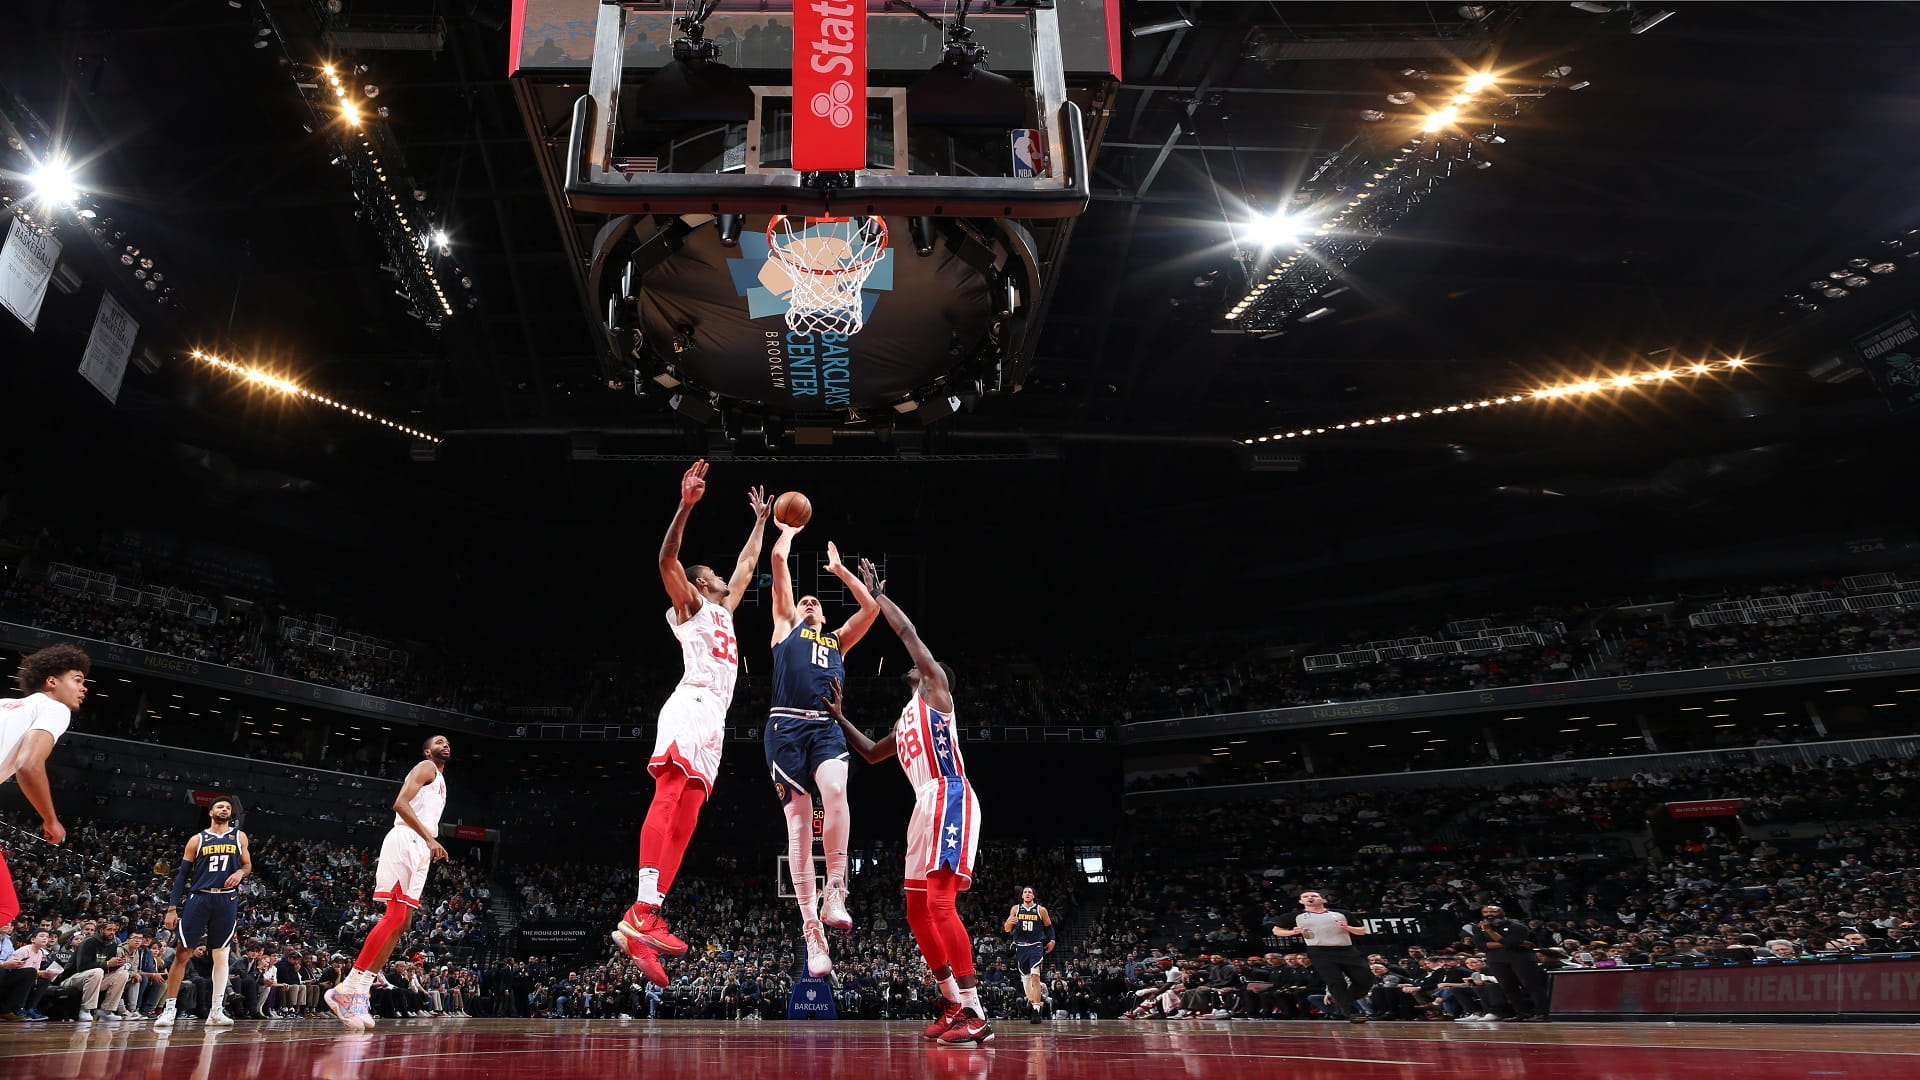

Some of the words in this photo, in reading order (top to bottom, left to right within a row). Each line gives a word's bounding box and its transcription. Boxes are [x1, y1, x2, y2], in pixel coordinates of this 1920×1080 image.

[811, 0, 855, 76] Stat
[1018, 169, 1033, 178] NBA
[14, 226, 51, 269] BASKETBALL
[100, 312, 131, 349] BASKETBALL
[110, 307, 128, 332] NETS
[1863, 326, 1919, 360] CHAMPIONS
[765, 331, 786, 389] BROOKLYN
[785, 330, 819, 399] CENTER
[821, 331, 851, 405] BARCLAYS
[800, 628, 838, 650] DENVER
[144, 654, 199, 674] NUGGETS
[811, 641, 829, 668] 15
[1726, 666, 1788, 680] NETS
[360, 697, 387, 711] NETS
[1311, 703, 1399, 718] NUGGETS
[899, 728, 923, 769] 28
[202, 844, 237, 856] DENVER
[208, 855, 230, 872] 27
[1022, 920, 1033, 931] 50
[1655, 974, 1737, 1004] CLEAN.
[1743, 970, 1872, 1002] HEALTHY.
[794, 1003, 829, 1011] BARCLAYS
